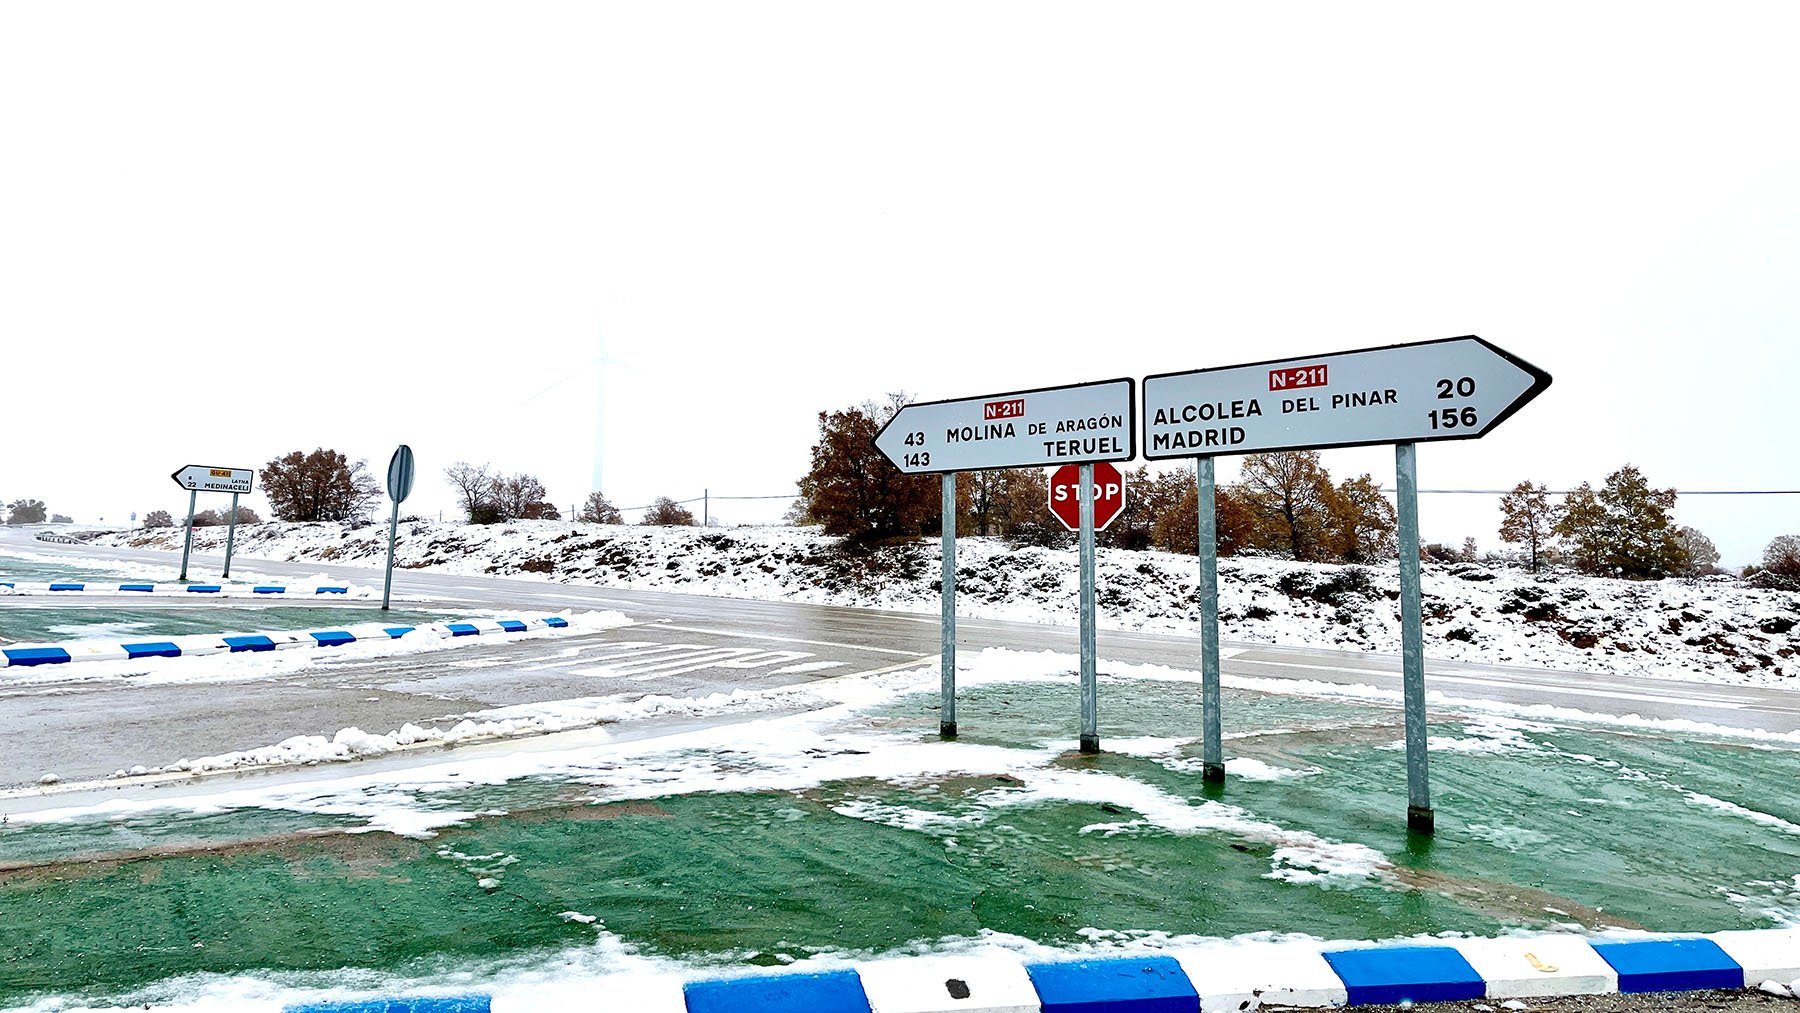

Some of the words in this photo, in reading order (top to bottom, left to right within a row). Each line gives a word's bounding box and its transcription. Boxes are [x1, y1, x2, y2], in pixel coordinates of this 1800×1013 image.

[1272, 368, 1325, 388] N-211
[1436, 377, 1475, 399] 20
[986, 402, 1023, 417] N-211
[1153, 399, 1262, 425] ALCOLEA
[1282, 397, 1319, 413] DEL
[1332, 389, 1398, 409] PINAR
[1428, 407, 1477, 429] 156
[947, 423, 1016, 443] MOLINA
[1028, 423, 1047, 436] DE
[1055, 414, 1123, 433] ARAGÓN
[1153, 427, 1245, 450] MADRID
[904, 432, 925, 446] 43
[1043, 436, 1123, 457] TERUEL
[903, 452, 930, 467] 143
[205, 482, 248, 491] MEDINACELI
[1054, 483, 1119, 501] STOP
